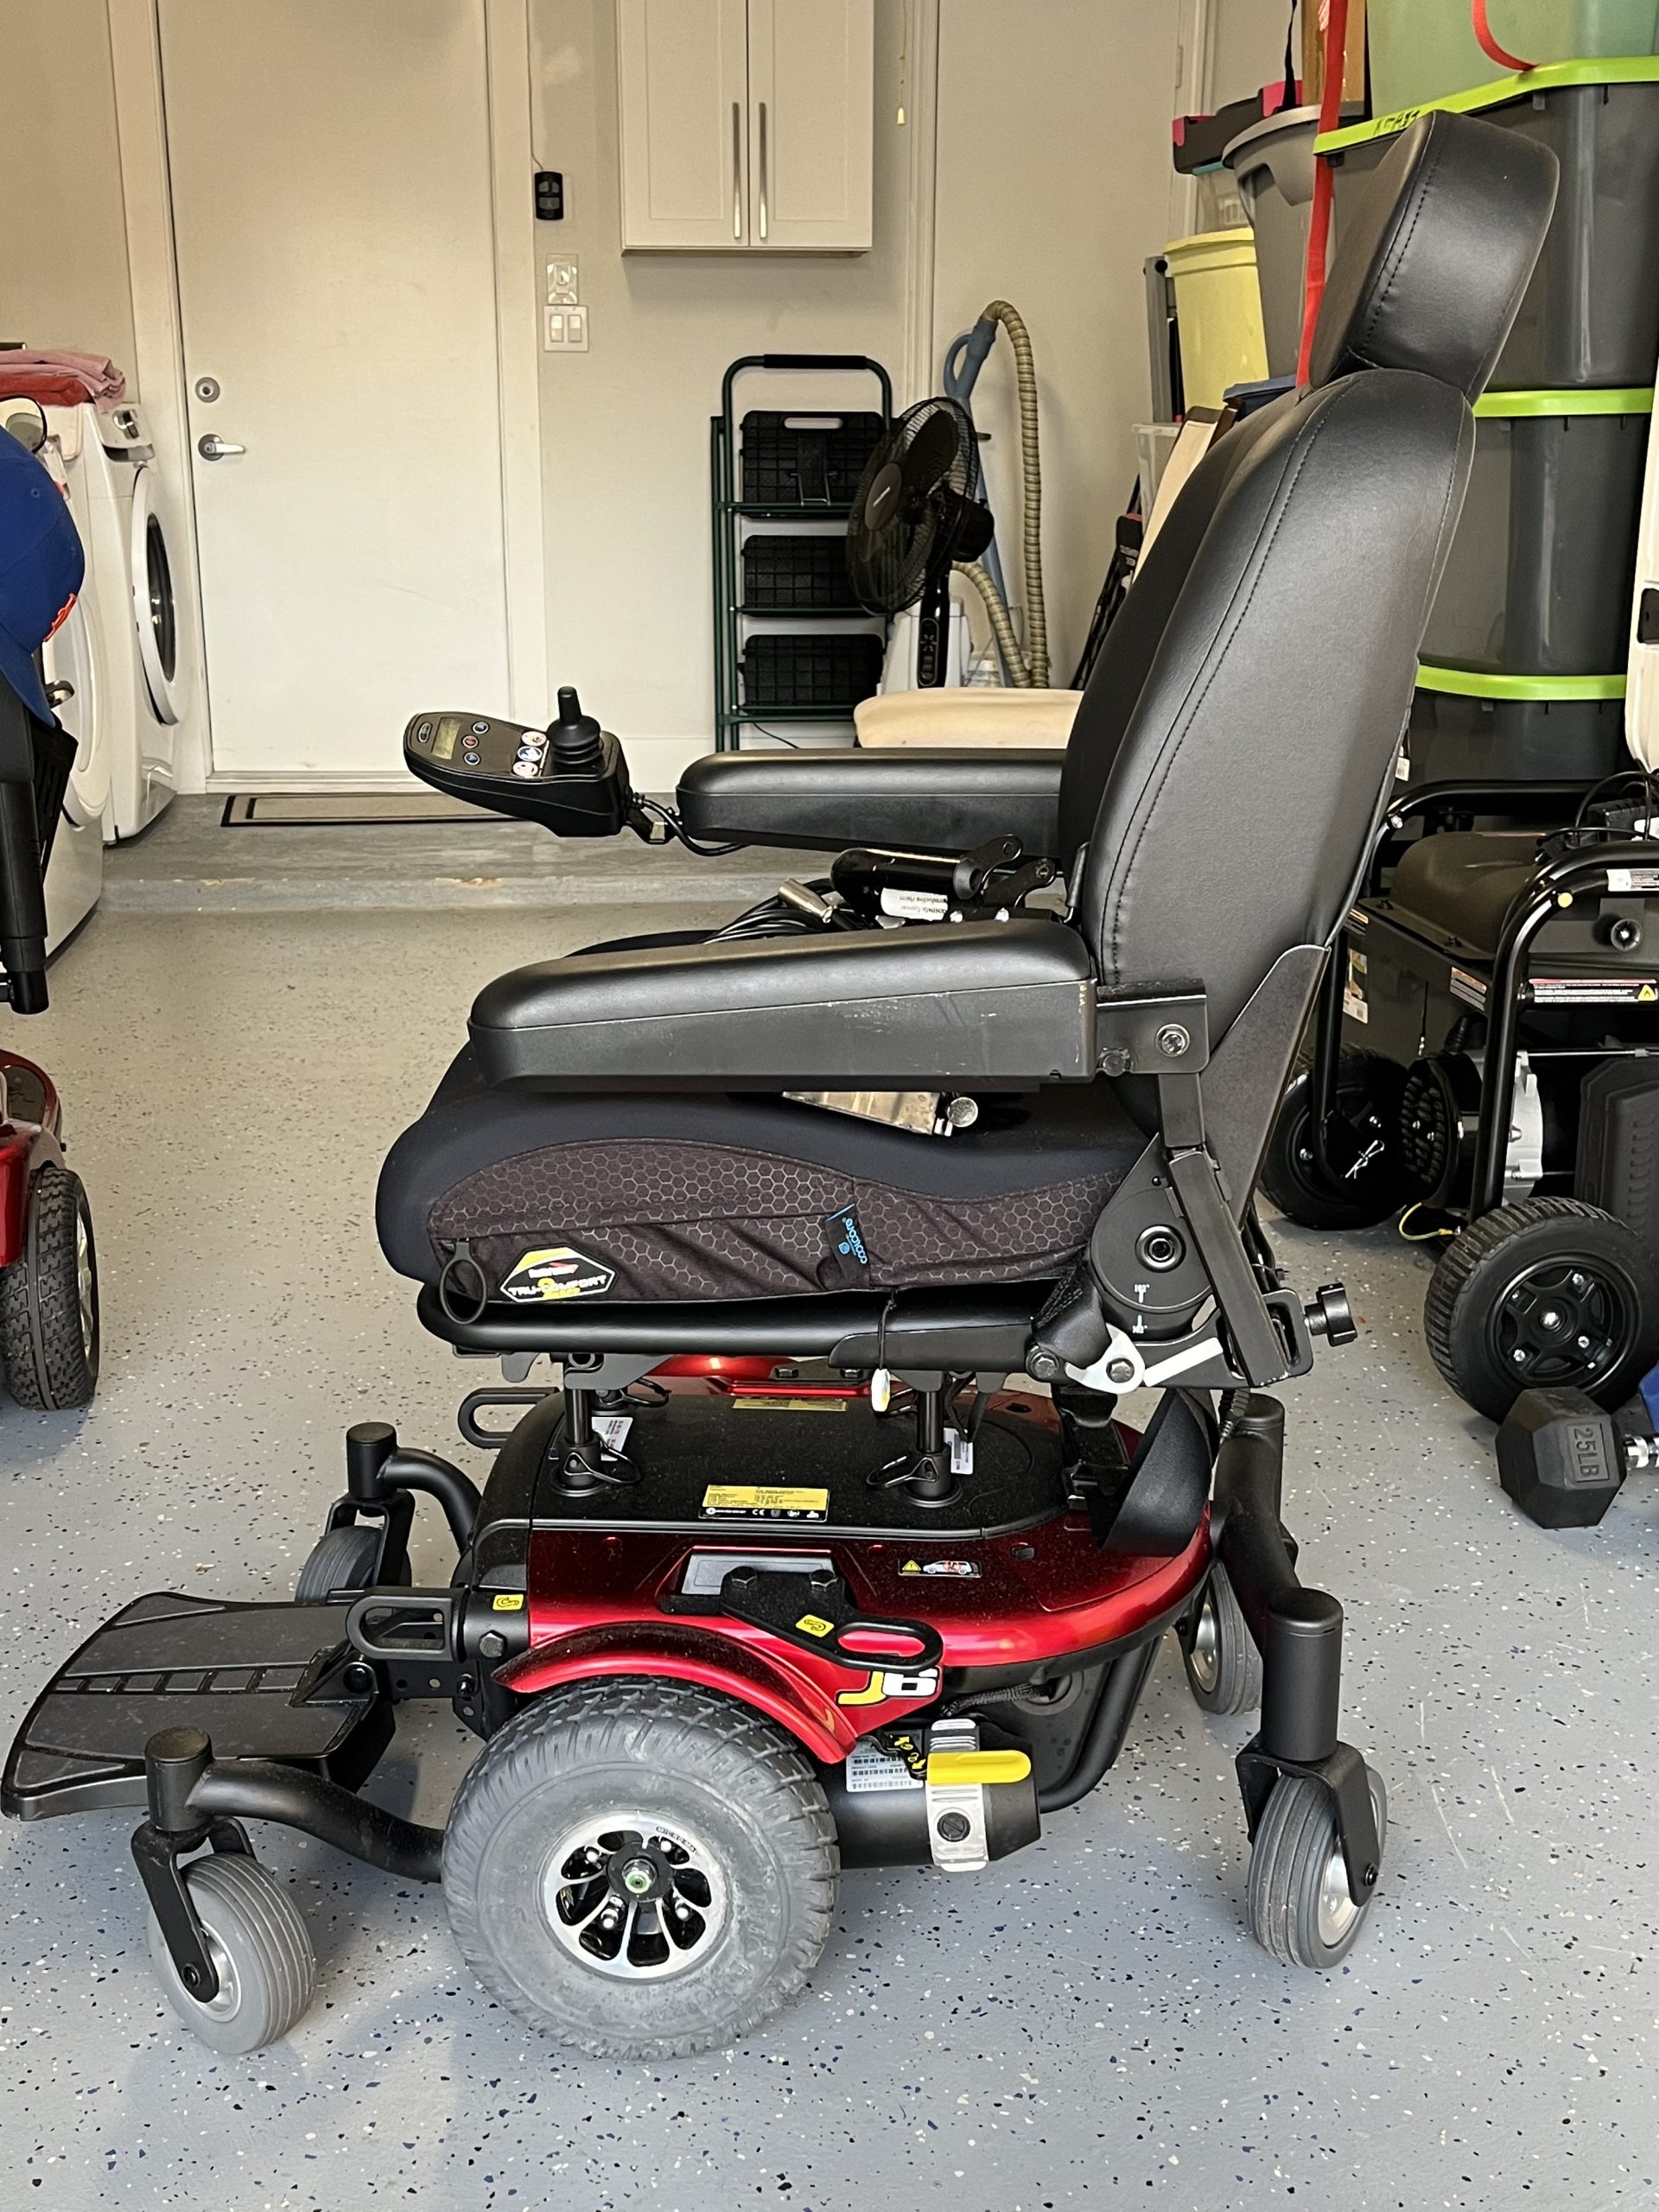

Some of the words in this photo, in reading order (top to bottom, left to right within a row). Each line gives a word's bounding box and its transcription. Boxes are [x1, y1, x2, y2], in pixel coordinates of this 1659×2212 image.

[845, 1218, 868, 1264] coolcore
[1573, 1427, 1600, 1477] 25LB
[837, 1668, 938, 1706] J6
